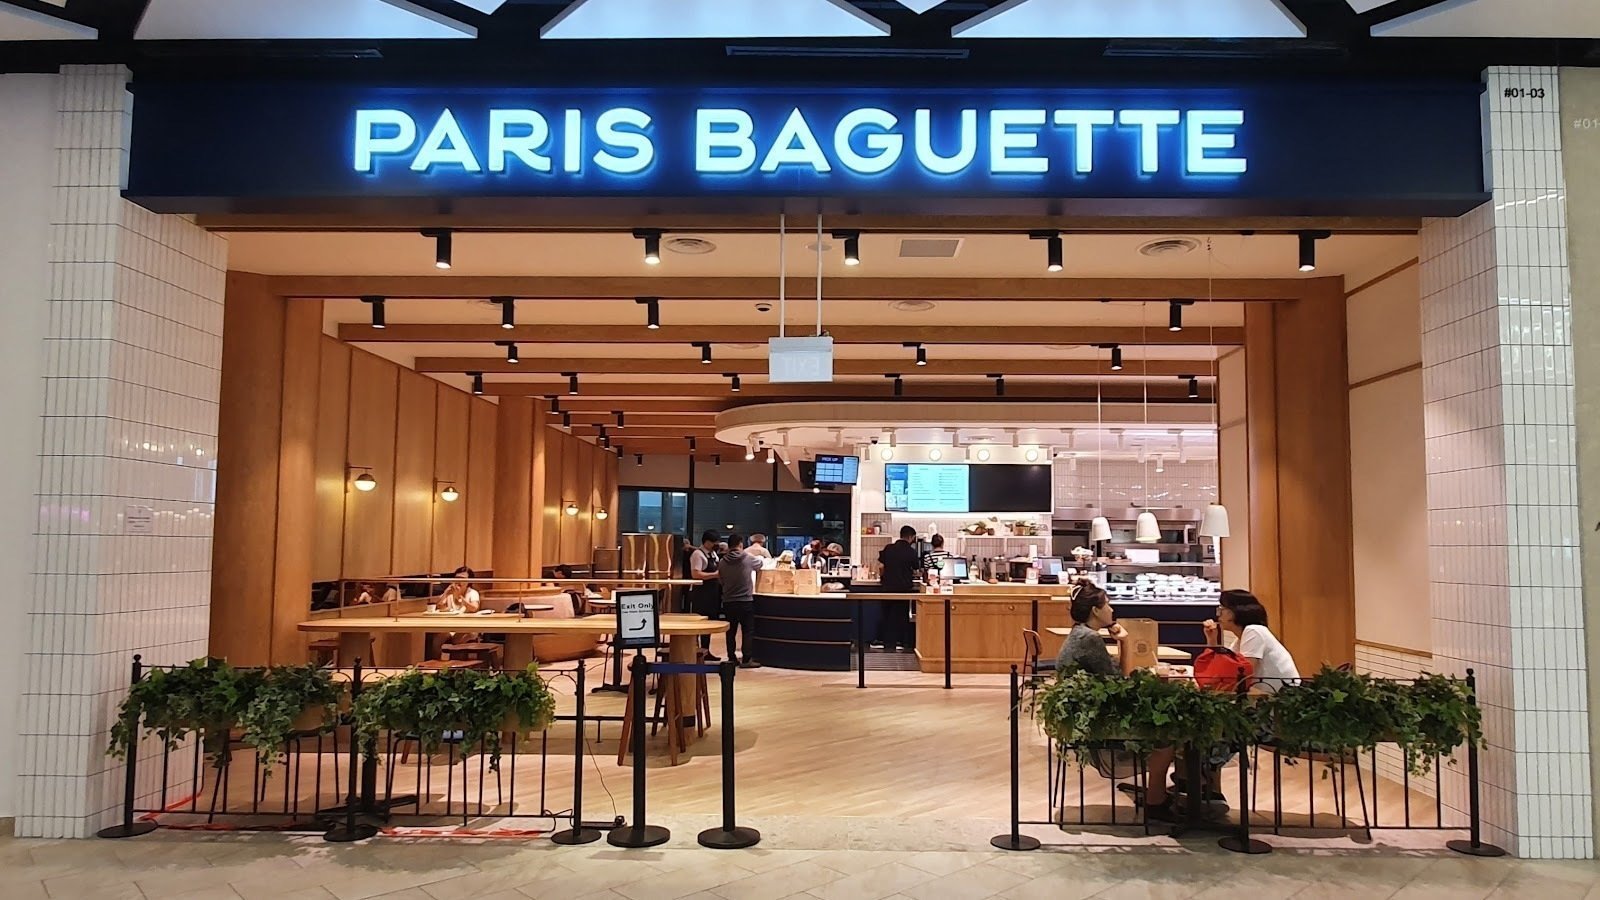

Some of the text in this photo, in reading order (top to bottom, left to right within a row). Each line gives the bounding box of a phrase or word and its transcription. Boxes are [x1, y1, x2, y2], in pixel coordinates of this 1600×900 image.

[1504, 87, 1545, 98] #01-03
[353, 107, 1247, 175] PARIS BAGUETTE
